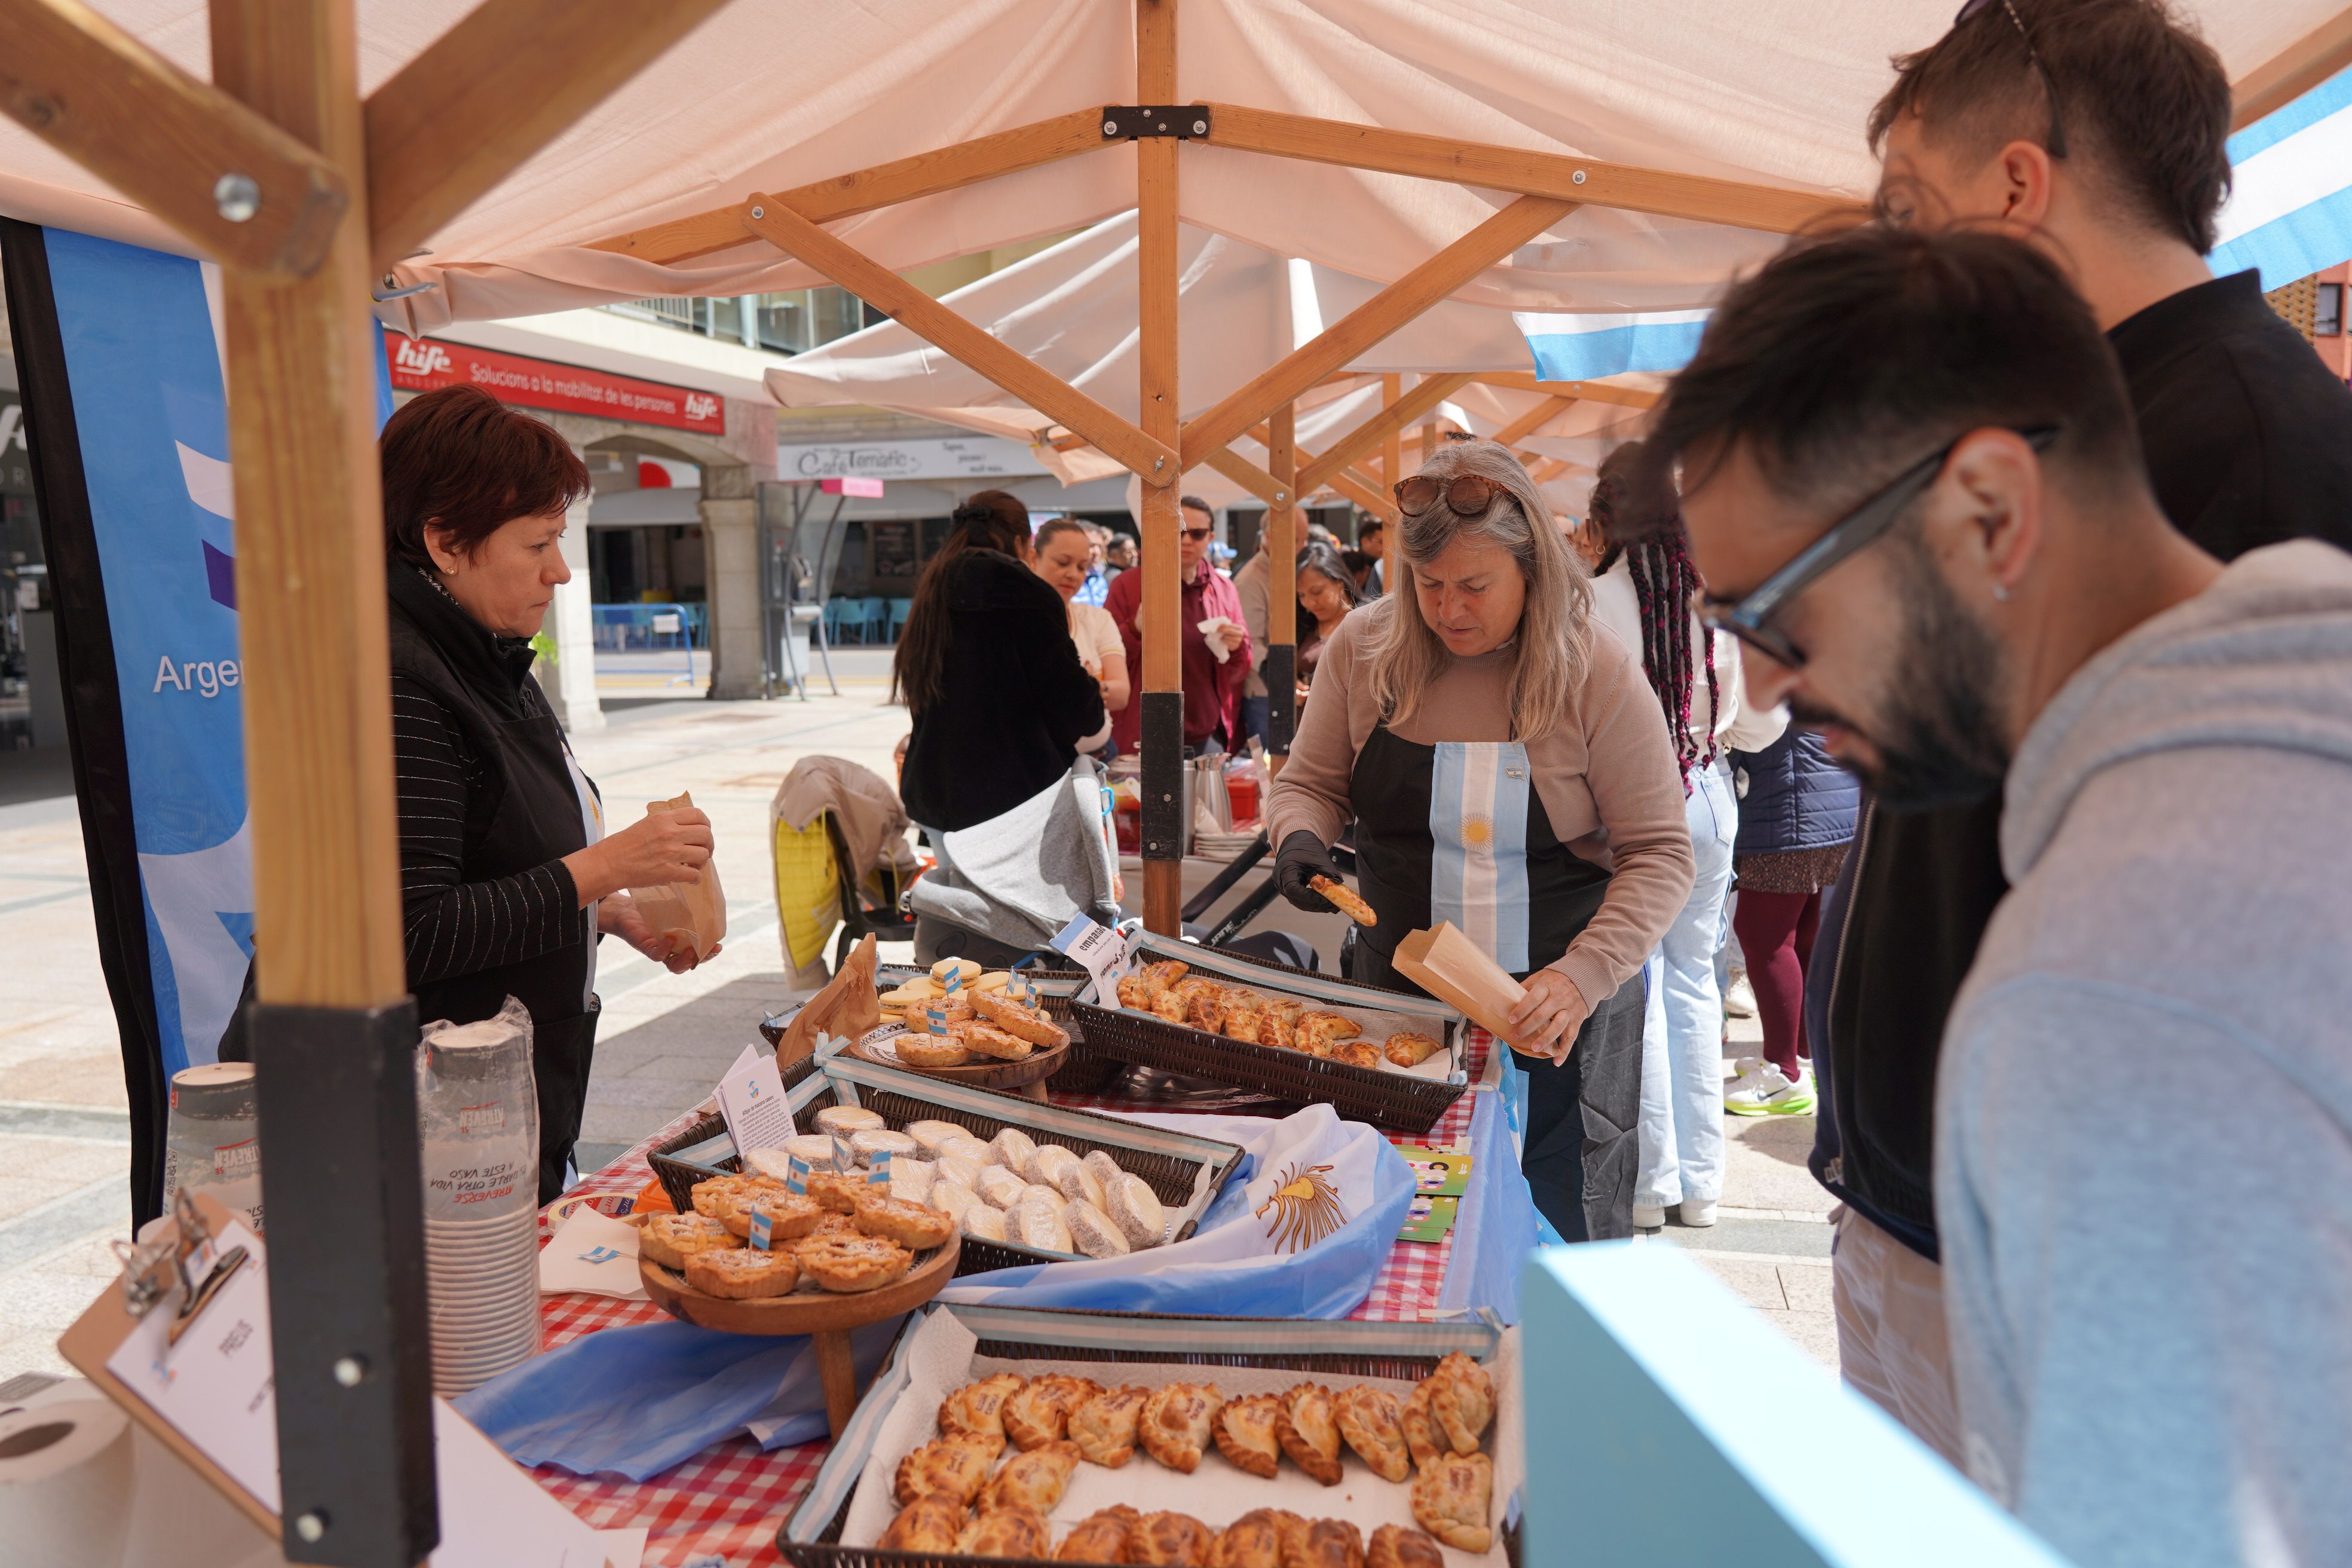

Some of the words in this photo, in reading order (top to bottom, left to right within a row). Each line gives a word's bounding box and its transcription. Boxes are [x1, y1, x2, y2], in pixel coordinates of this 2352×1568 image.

[396, 339, 454, 376] hife
[470, 362, 529, 390] Solucions
[530, 375, 540, 391] a
[540, 373, 553, 394] la
[555, 379, 604, 403] mobilitat
[604, 384, 618, 405] de
[620, 388, 632, 408] les
[634, 394, 676, 415] persones
[685, 392, 719, 421] hife
[742, 1107, 751, 1116] Alfajor
[754, 1100, 765, 1109] maicena
[765, 1095, 774, 1103] casero
[459, 1107, 504, 1128] ATREVEN
[449, 1168, 478, 1180] VASO
[481, 1163, 506, 1178] ESTE
[488, 1171, 519, 1188] DARLE
[430, 1178, 453, 1191] VIDA
[452, 1184, 514, 1204] ATREVERSE
[457, 1181, 485, 1192] OTRA
